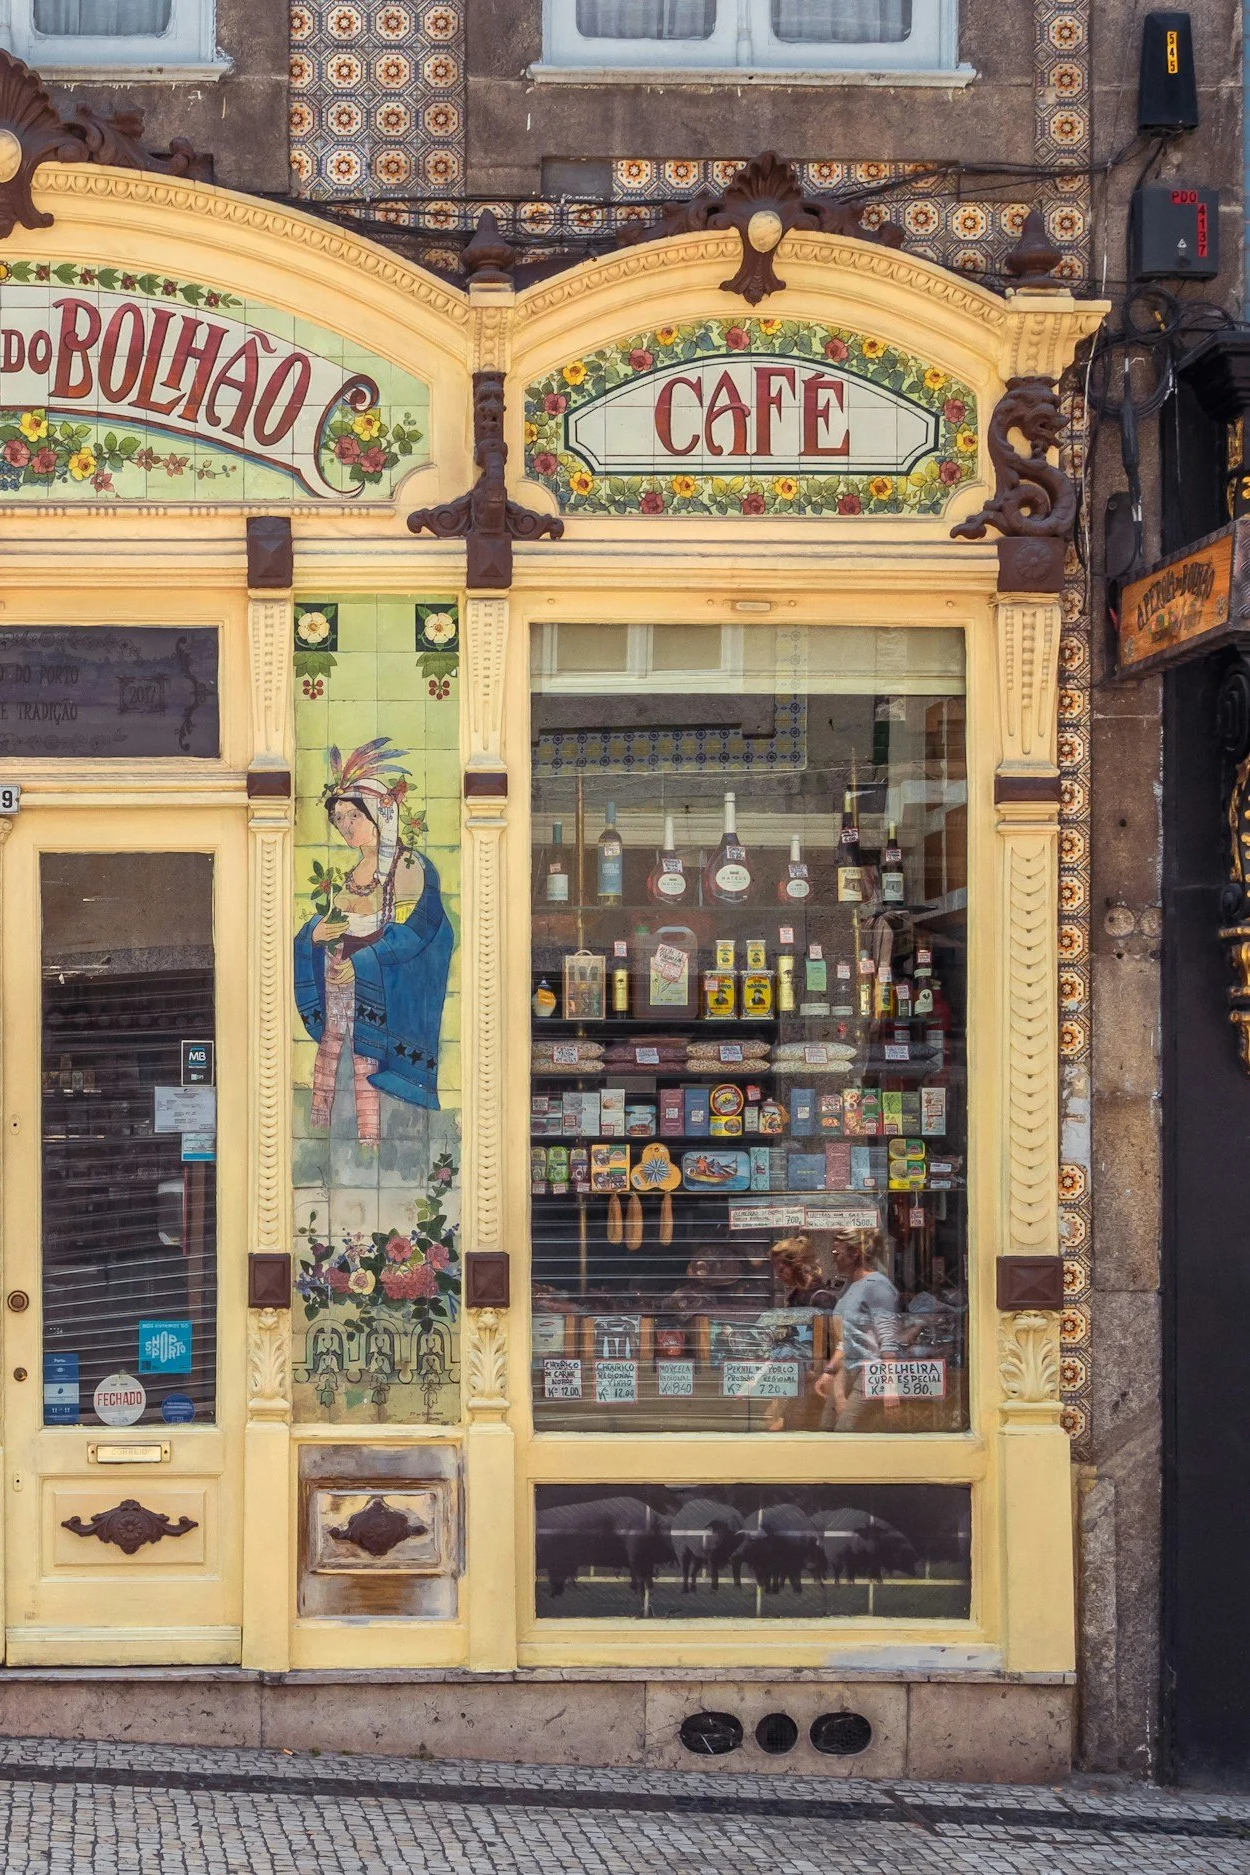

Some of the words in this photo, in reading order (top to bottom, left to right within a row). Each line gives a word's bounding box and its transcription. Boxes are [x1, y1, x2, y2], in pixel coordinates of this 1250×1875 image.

[0, 328, 52, 374] DO
[48, 297, 312, 446] BOLHÃO
[654, 367, 850, 457] CAFÉ
[15, 664, 32, 684] DO
[17, 699, 79, 725] TRADIÇÃO
[188, 1051, 206, 1062] MB
[869, 1362, 940, 1375] ORELHEIRA
[868, 1375, 894, 1385] CURA
[897, 1374, 942, 1384] ESPECIAL
[97, 1391, 143, 1407] FECHADO
